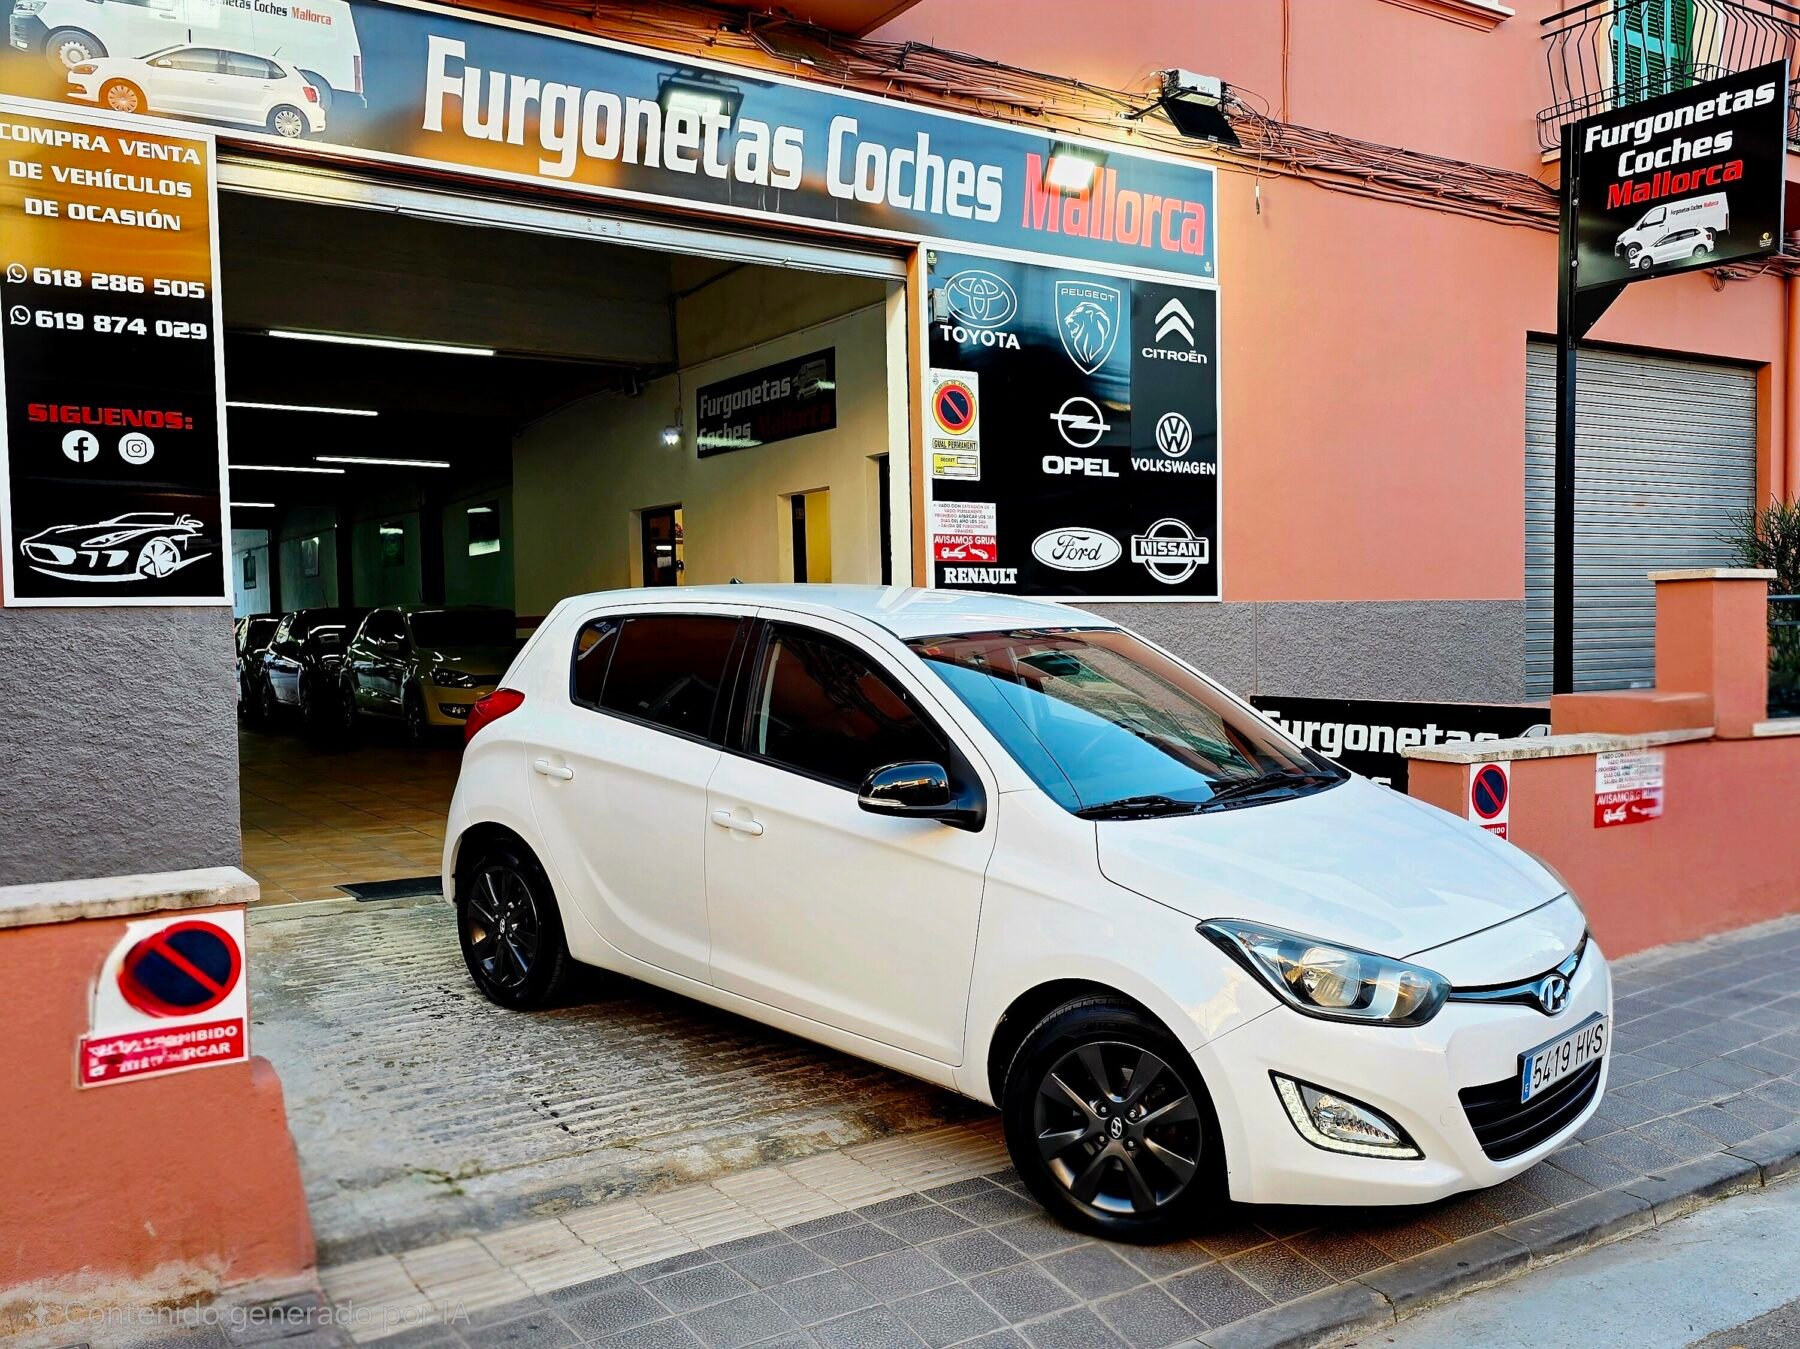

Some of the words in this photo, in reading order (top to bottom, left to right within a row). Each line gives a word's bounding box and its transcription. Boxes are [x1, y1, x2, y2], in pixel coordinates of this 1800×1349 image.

[254, 0, 288, 17] Coches
[291, 6, 332, 25] Mallorca
[1584, 81, 1776, 153] Furgonetas
[0, 123, 110, 153] COMPRA
[118, 139, 201, 165] VENTA
[422, 34, 804, 191] Furgonetas
[826, 115, 1003, 223] Coches
[1022, 152, 1206, 256] Mallorca
[1617, 130, 1733, 178] Coches
[8, 160, 43, 180] DE
[51, 165, 192, 198] VEHÍCULOS
[1606, 159, 1743, 210] Mallorca
[24, 198, 59, 218] DE
[67, 203, 181, 231] OCASIÓN
[33, 267, 82, 289] 618
[92, 272, 145, 293] 286
[153, 278, 205, 299] 505
[1060, 287, 1115, 303] PEUGEOT
[35, 310, 84, 331] 619
[93, 315, 147, 336] 874
[155, 320, 207, 340] 029
[939, 324, 1020, 350] TOYOTA
[700, 376, 791, 420] Furgonetas
[27, 403, 193, 430] SIGUENOS:
[1042, 455, 1119, 478] OPEL
[1131, 457, 1216, 475] VOLKSWAGEN
[934, 535, 973, 545] AVISAMOS
[975, 536, 996, 545] GRUA
[1052, 534, 1102, 561] Ford
[1140, 541, 1200, 557] NISSAN
[944, 566, 1018, 585] RENAULT
[1597, 791, 1636, 806] AVISAMOS
[1533, 1041, 1571, 1089] 5419
[1575, 1023, 1604, 1065] HVS
